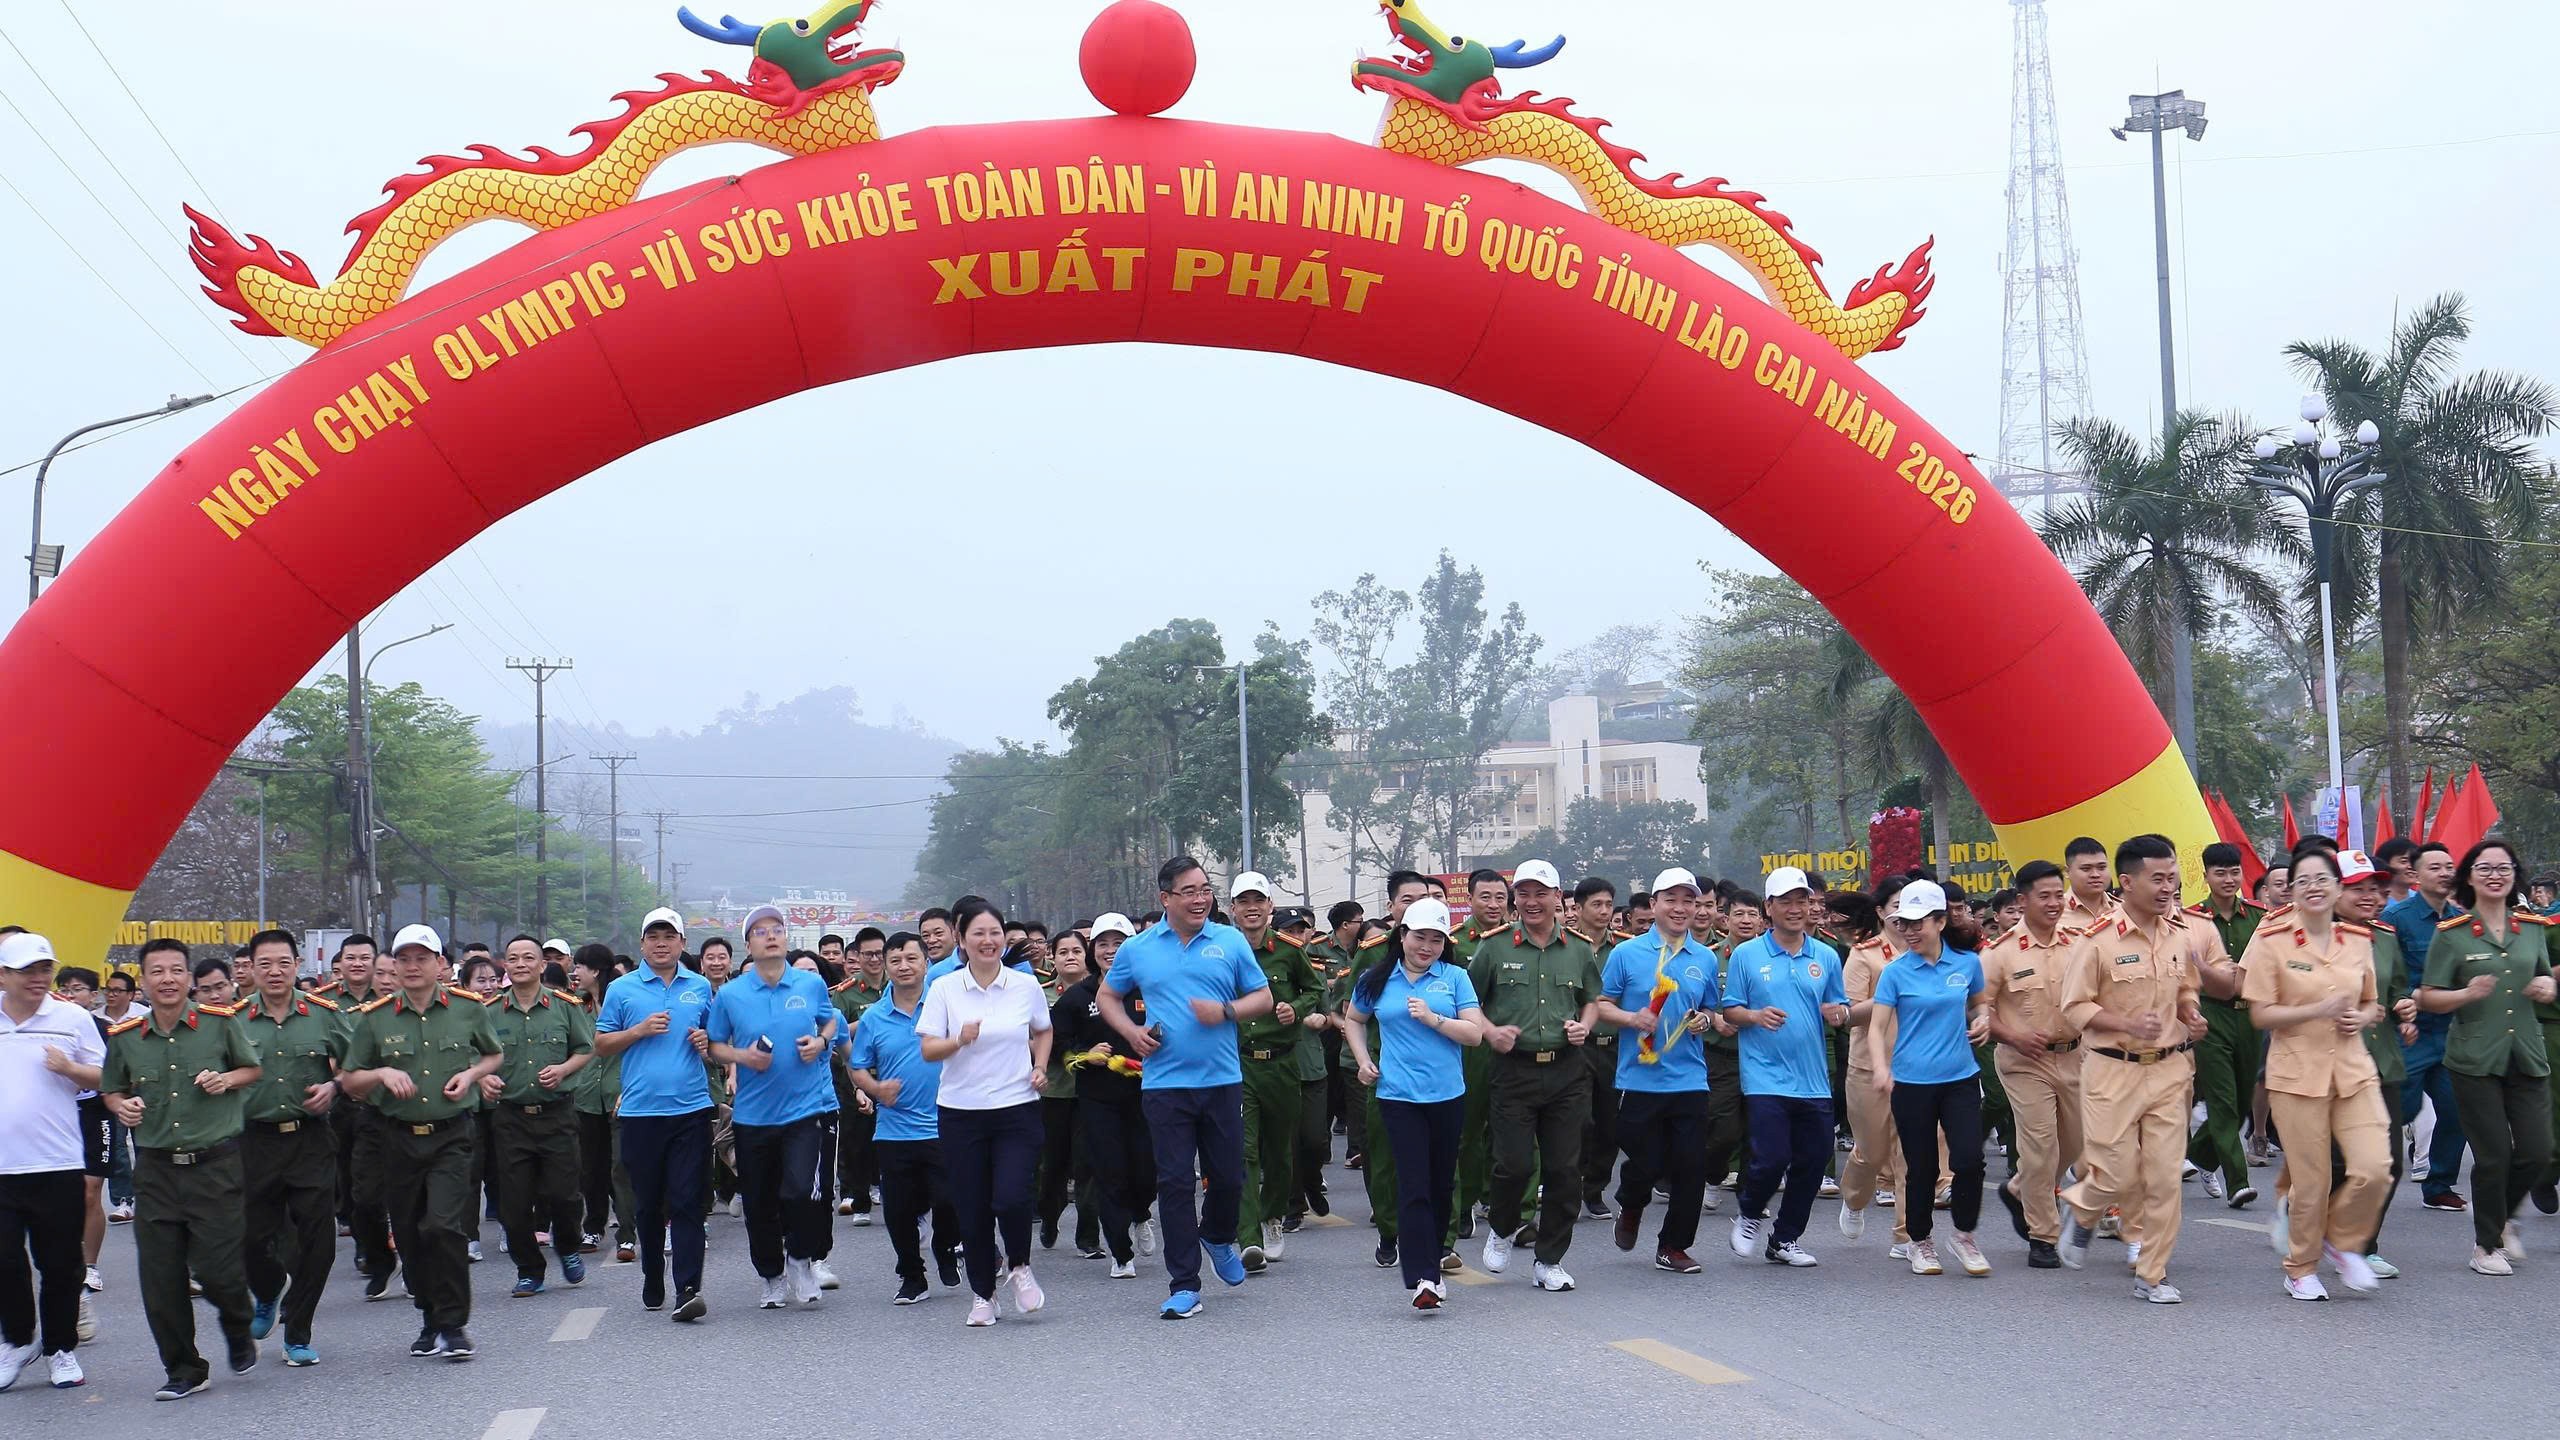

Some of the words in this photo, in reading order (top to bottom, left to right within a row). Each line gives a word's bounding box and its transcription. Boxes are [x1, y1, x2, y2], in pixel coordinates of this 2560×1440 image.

[927, 227, 1146, 305] XUẤT
[1171, 249, 1384, 314] PHÁT
[199, 427, 320, 540] NGÀY
[313, 354, 430, 454] CHẠY
[432, 260, 627, 381] OLYMPIC
[699, 205, 792, 273] SỨC
[797, 173, 918, 249] KHỎE
[926, 161, 1045, 225] TOÀN
[1056, 155, 1146, 215] DÂN
[1179, 159, 1217, 217] VÌ
[1230, 172, 1289, 225] AN
[1301, 180, 1404, 245] NINH
[1423, 194, 1471, 257] TỔ
[1480, 218, 1583, 289] QUỐC
[1592, 252, 1678, 333] TỈNH
[1676, 300, 1749, 370] LÀO
[1754, 342, 1817, 407] CAI
[1813, 377, 1898, 462] NĂM
[1895, 441, 1977, 524] 2026
[1818, 841, 1866, 872] MỚI
